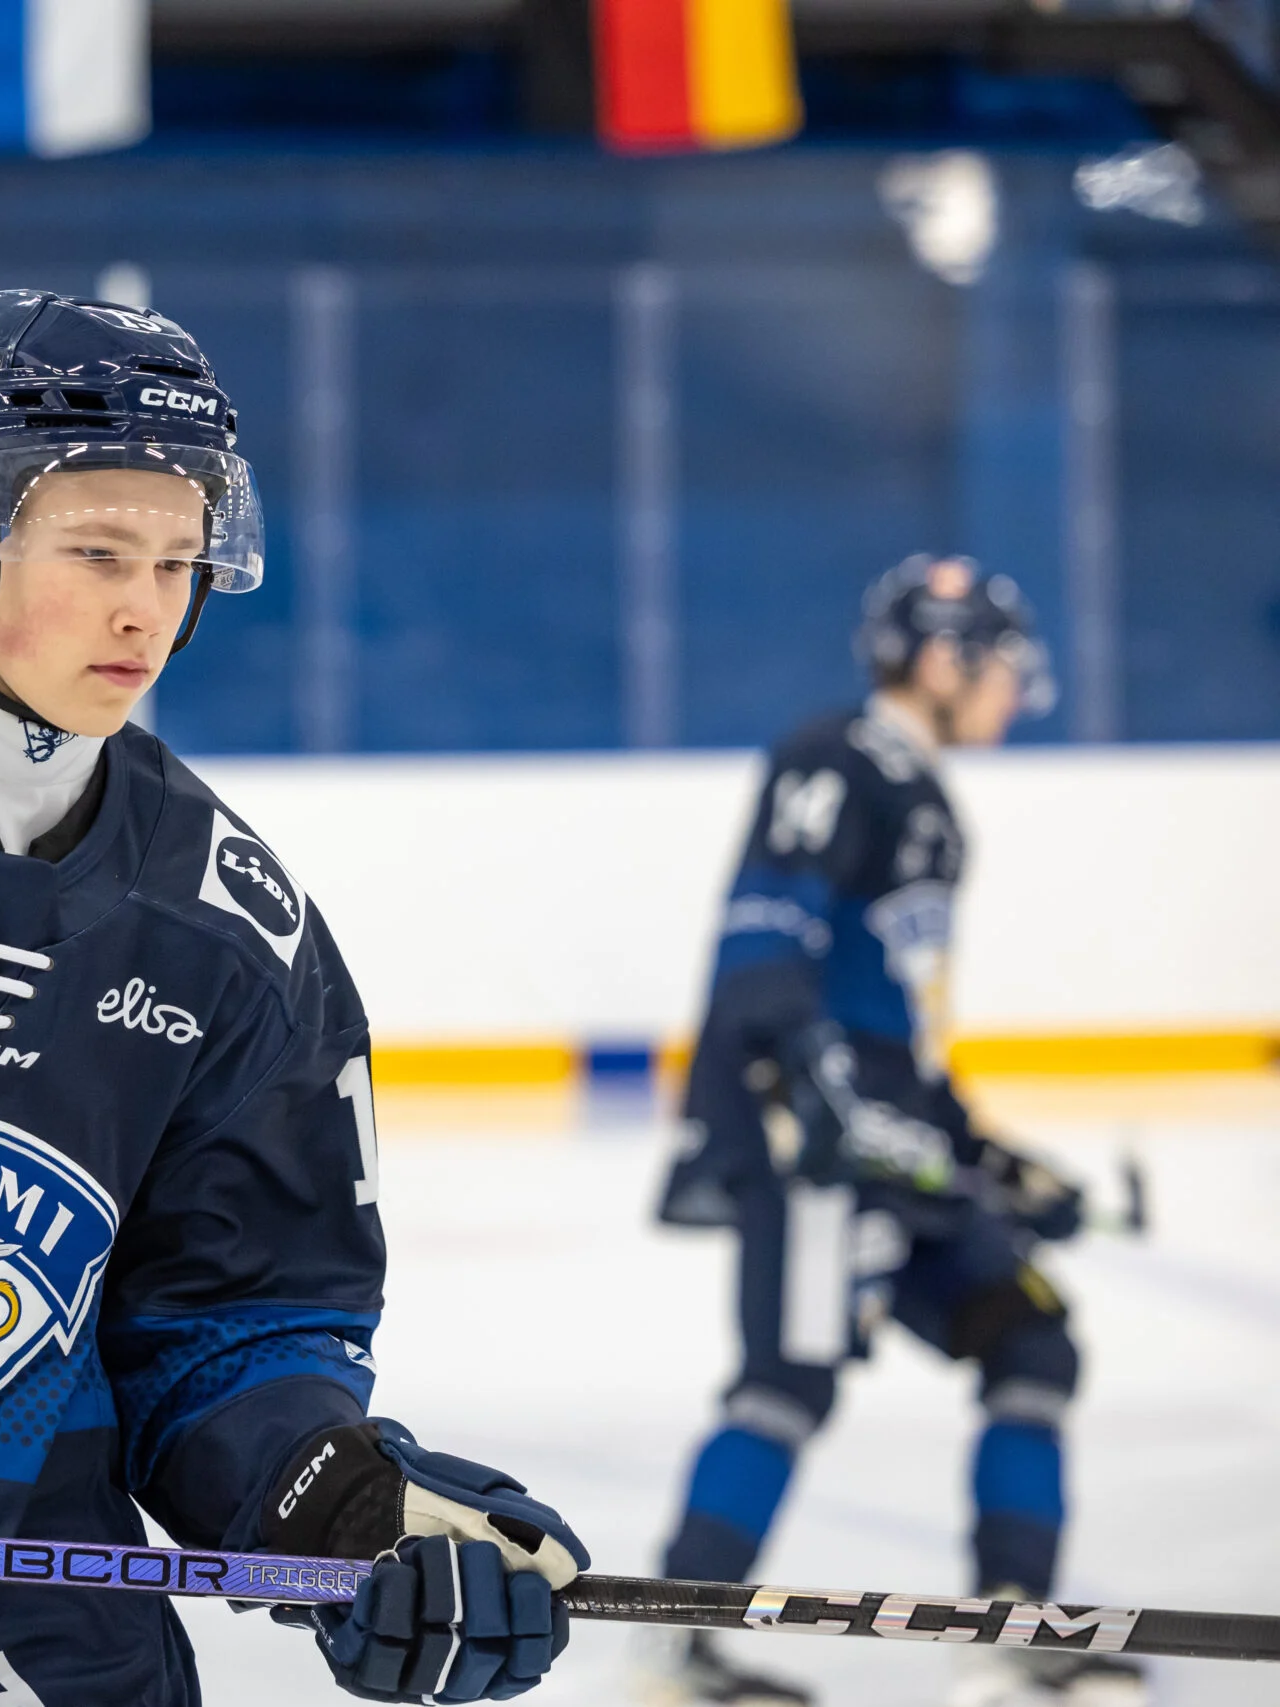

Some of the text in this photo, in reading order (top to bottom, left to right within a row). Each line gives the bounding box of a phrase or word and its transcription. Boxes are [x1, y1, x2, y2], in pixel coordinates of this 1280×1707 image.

[140, 387, 218, 416] CCM
[97, 977, 204, 1044] elisa
[335, 1055, 379, 1206] 1
[278, 1441, 336, 1519] CCM
[742, 1585, 1144, 1653] CCM
